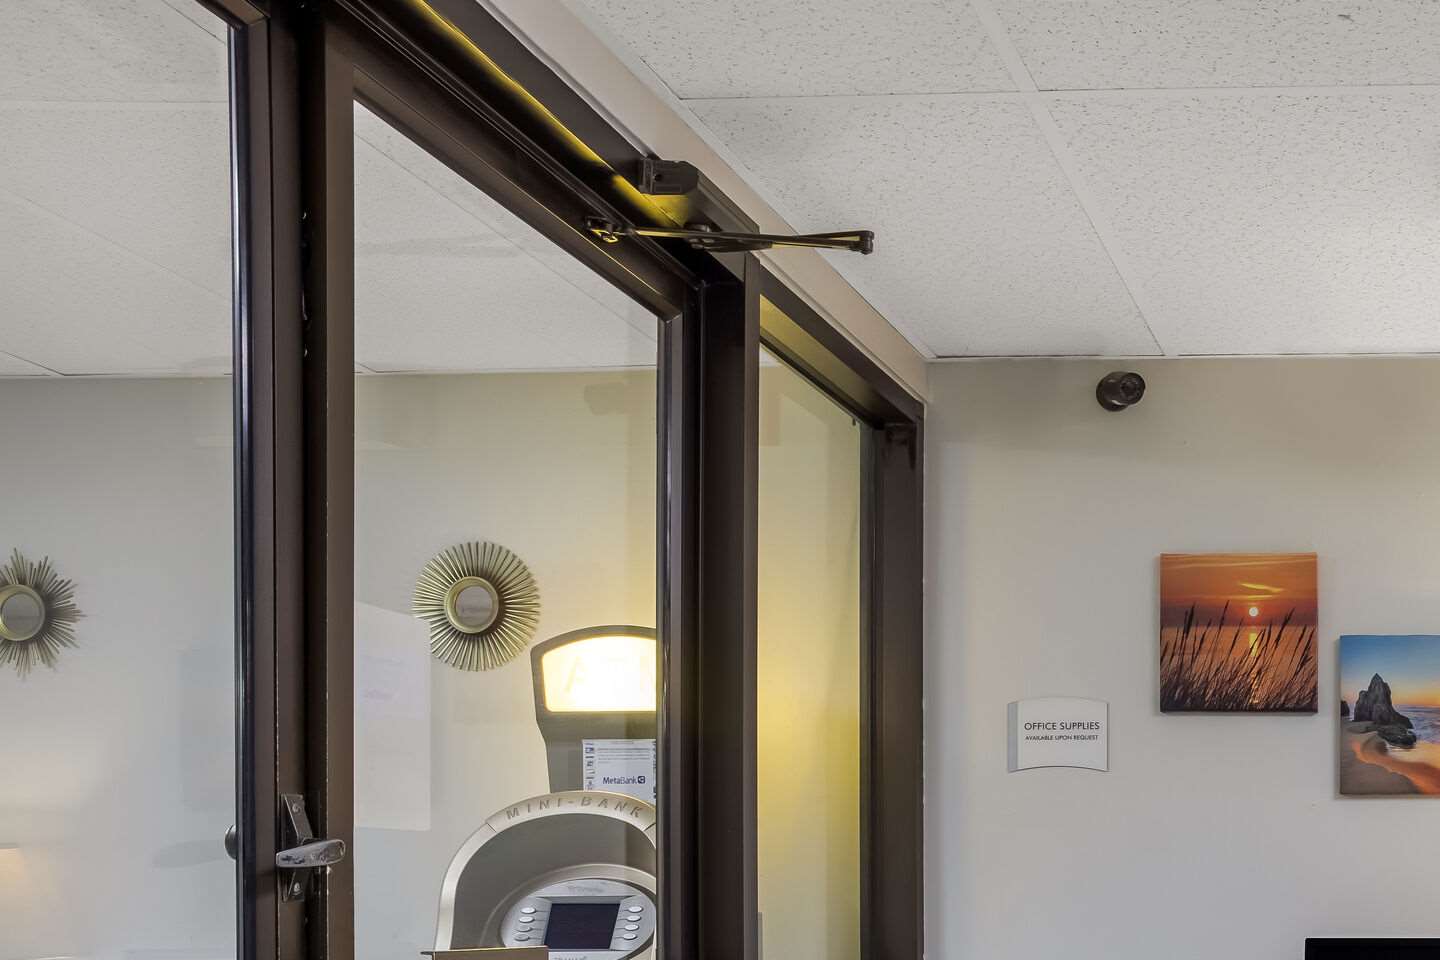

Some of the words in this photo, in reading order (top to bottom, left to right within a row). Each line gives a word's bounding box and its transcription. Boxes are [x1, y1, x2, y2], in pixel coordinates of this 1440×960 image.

[1024, 722, 1057, 730] OFFICE
[1060, 721, 1100, 730] SUPPLIES
[602, 776, 637, 785] MetaBank
